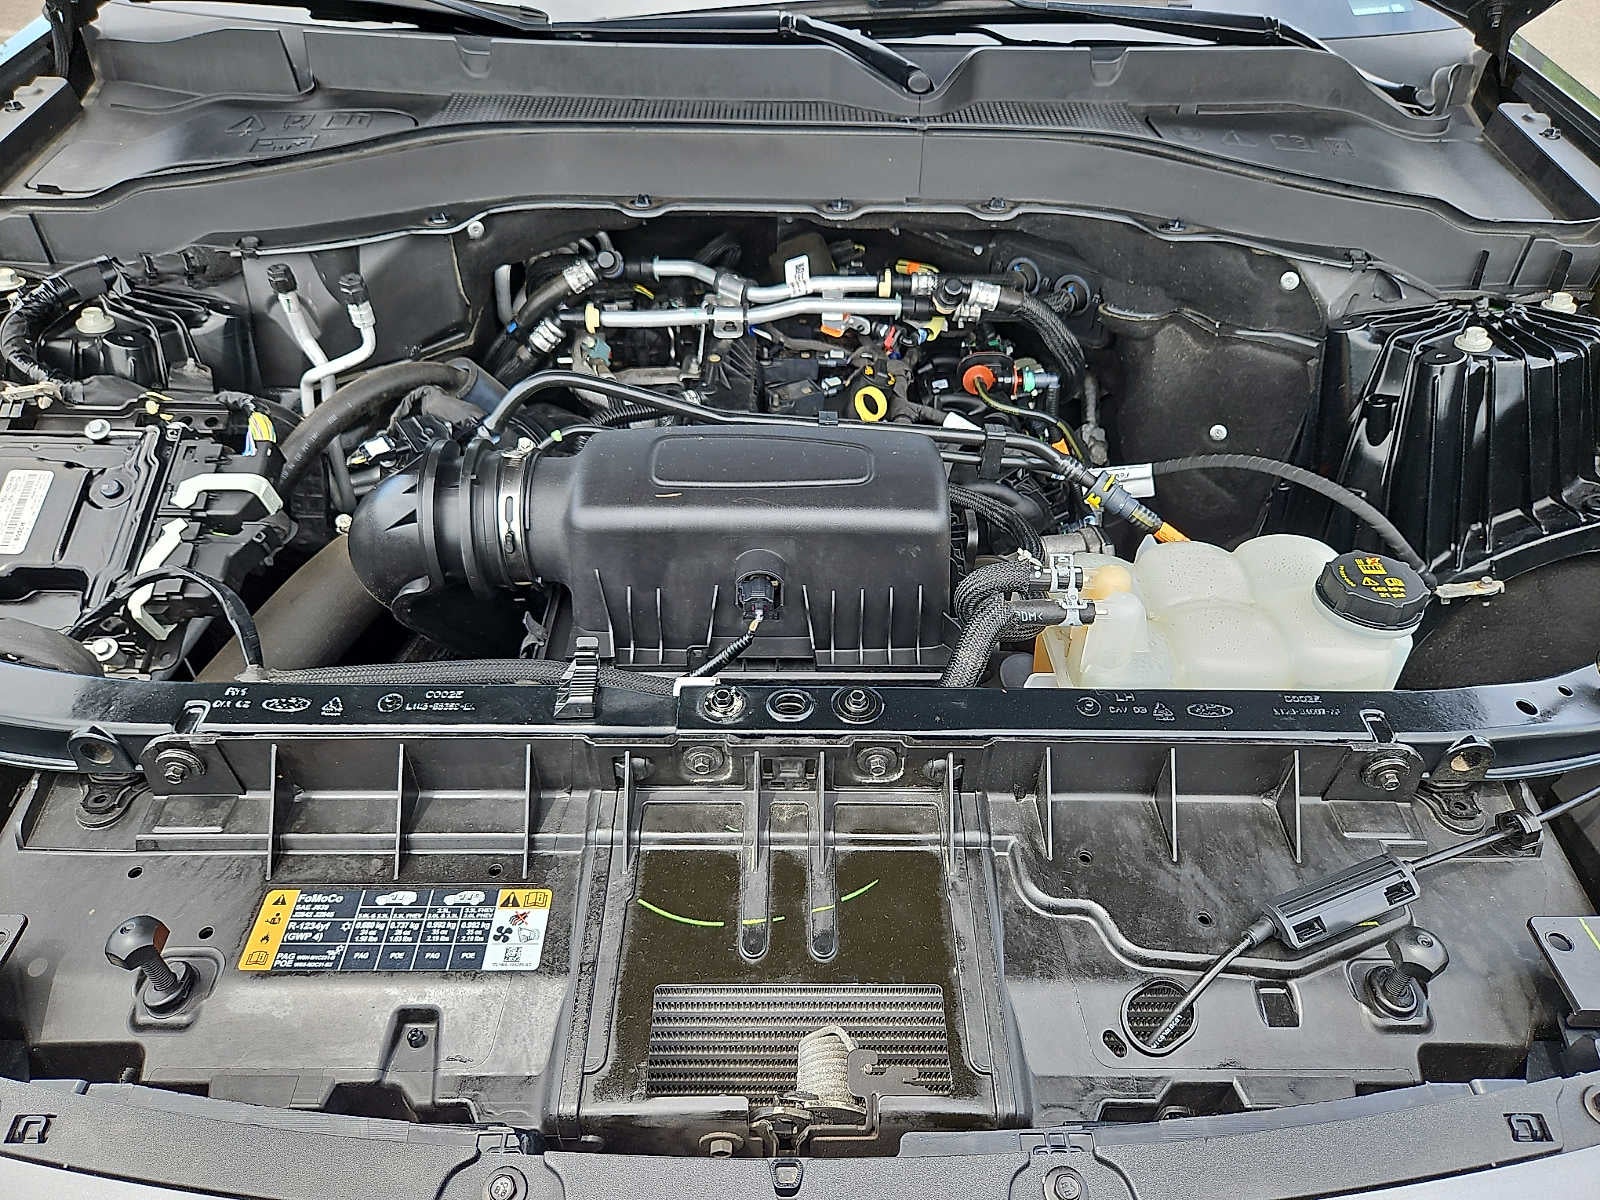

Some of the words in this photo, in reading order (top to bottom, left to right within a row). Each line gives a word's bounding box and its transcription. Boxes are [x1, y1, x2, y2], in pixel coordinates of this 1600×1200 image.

[297, 893, 344, 903] FoMoCo
[288, 921, 331, 932] R-1234yf
[446, 921, 457, 930] kg
[480, 921, 491, 930] kg
[283, 932, 312, 942] (GWP
[276, 952, 296, 960] PAG
